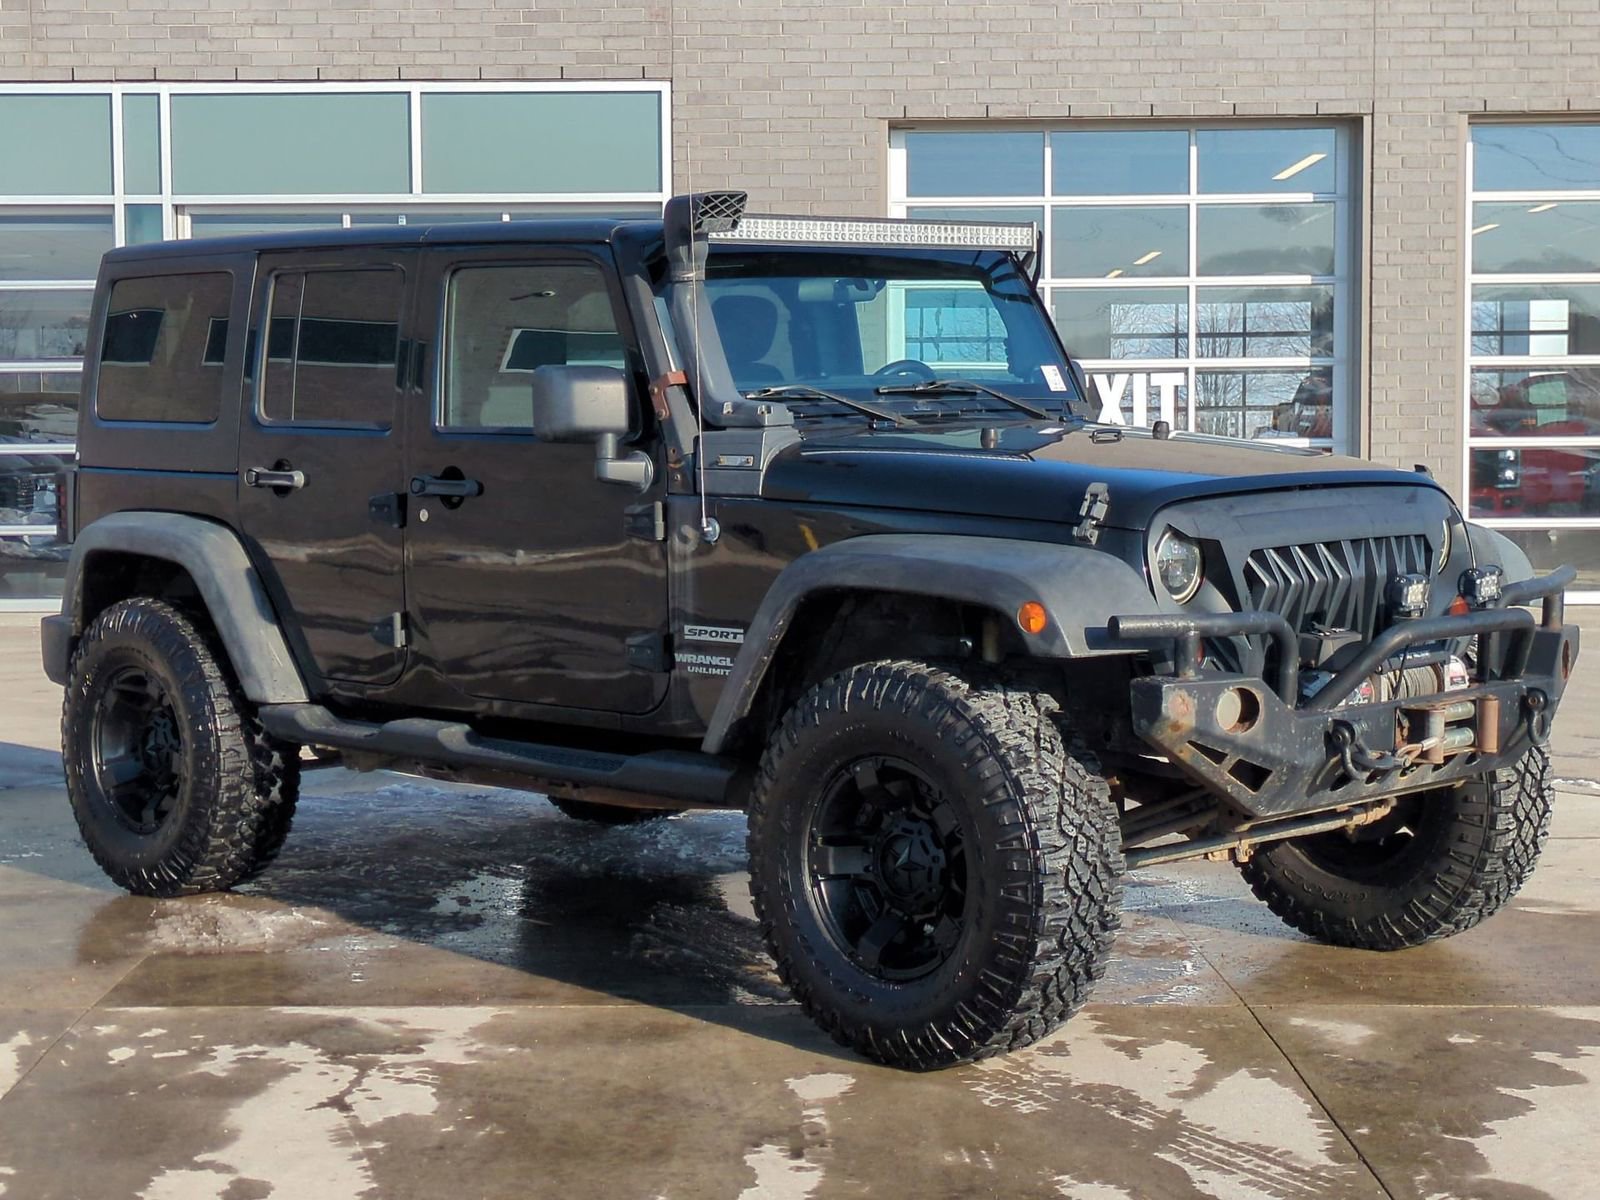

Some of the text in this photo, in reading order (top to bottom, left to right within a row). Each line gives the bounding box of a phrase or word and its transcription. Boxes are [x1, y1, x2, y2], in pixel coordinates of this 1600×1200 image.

[1085, 373, 1185, 430] XIT
[685, 627, 743, 641] SPORT
[674, 653, 736, 667] WRANGL
[687, 666, 731, 676] UNLIMIT
